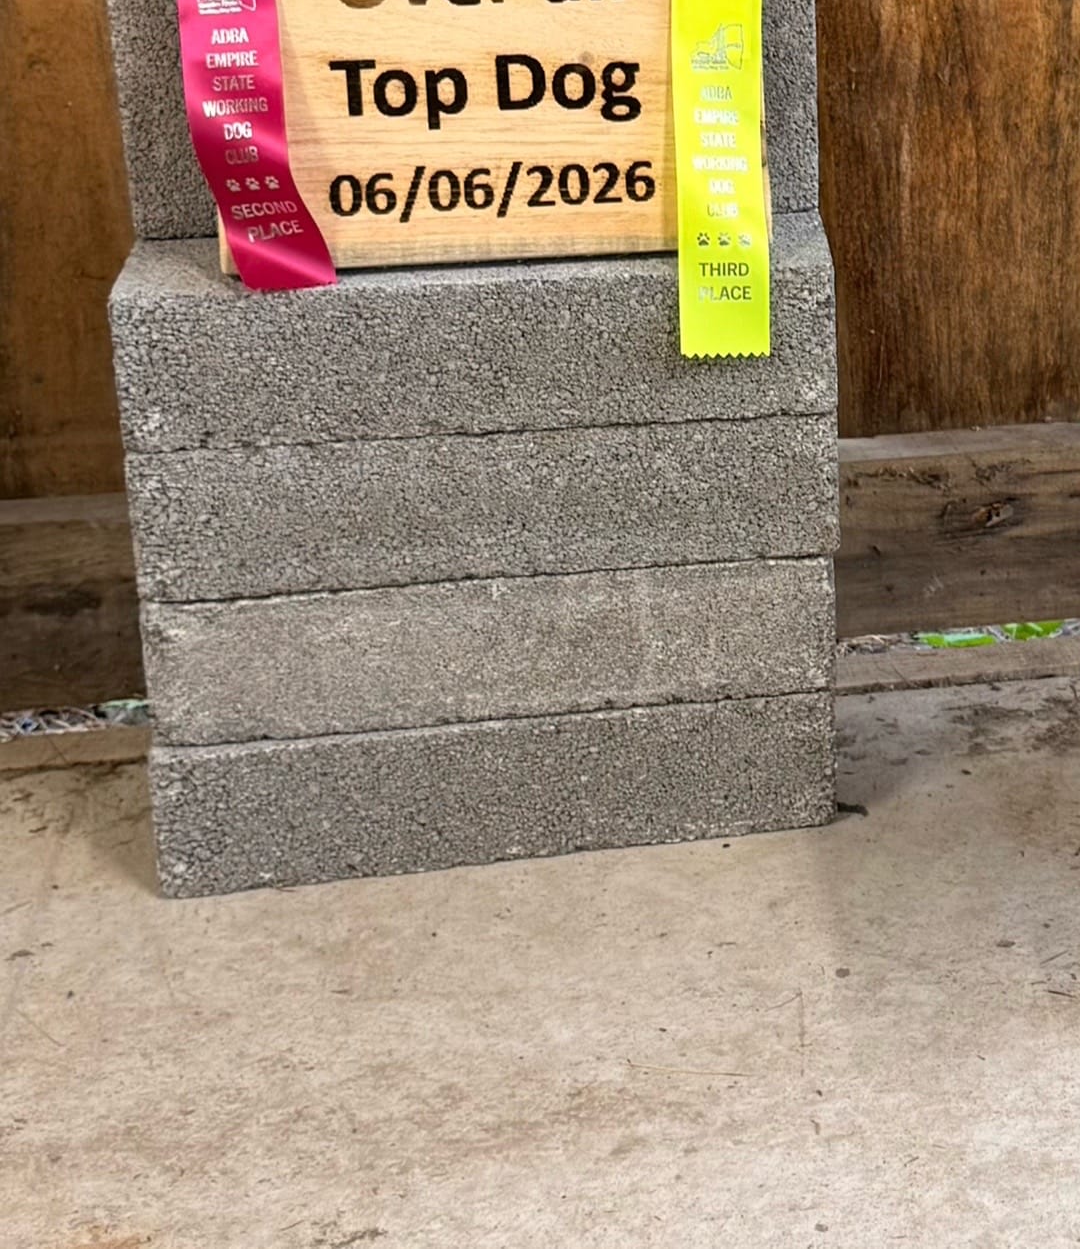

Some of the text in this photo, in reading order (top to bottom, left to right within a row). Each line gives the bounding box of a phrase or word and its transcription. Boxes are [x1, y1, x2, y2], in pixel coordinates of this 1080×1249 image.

[211, 27, 249, 45] ADBA
[205, 50, 259, 69] EMPIRE
[212, 74, 256, 92] STATE
[329, 53, 642, 130] Top Dog
[202, 97, 269, 118] WORKING
[223, 121, 253, 140] DOG
[225, 146, 259, 165] CLUB
[329, 160, 657, 224] 06/06/2026
[231, 200, 298, 220] SECOND
[248, 220, 303, 243] PLACE
[698, 262, 750, 277] THIRD
[698, 286, 752, 300] PLACE
